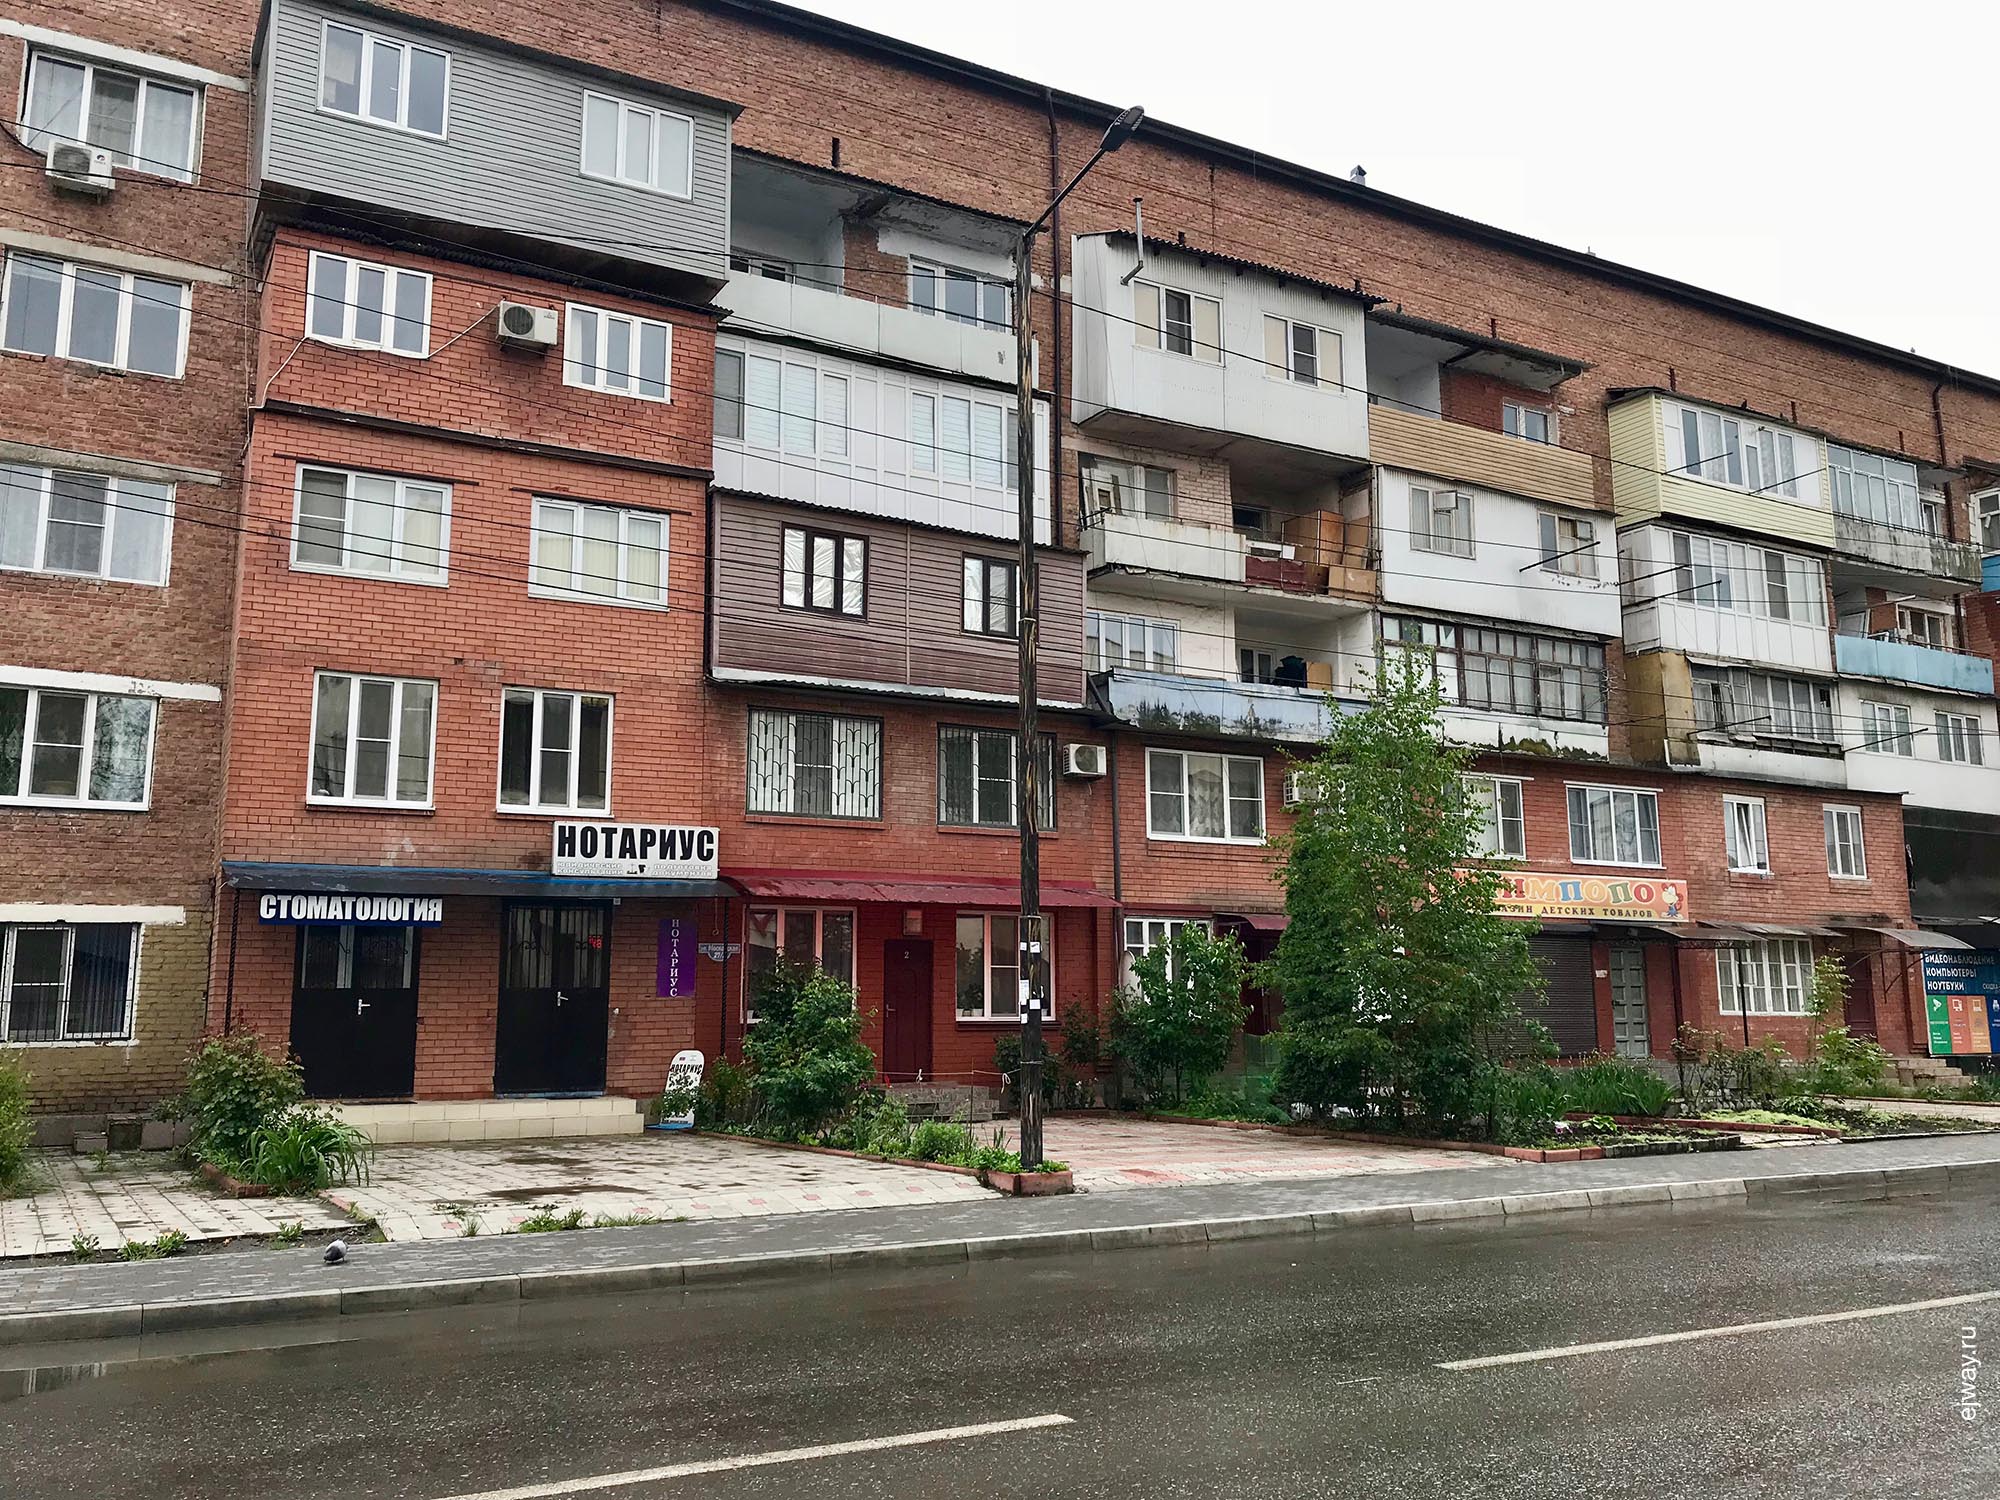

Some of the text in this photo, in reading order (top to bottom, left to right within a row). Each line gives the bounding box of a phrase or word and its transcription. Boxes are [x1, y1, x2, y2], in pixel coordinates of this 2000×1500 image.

[557, 825, 714, 862] НОТАРИУС
[1484, 877, 1655, 904] ИМПОПО
[259, 894, 443, 922] СТОМАТОЛОГИЯ
[1541, 905, 1595, 916] ДЕТСКИХ
[1602, 908, 1653, 918] ТОВАРОВ
[669, 919, 680, 997] НОТАРИУС
[1925, 953, 1995, 965] ВИДЕОНАБЛЮДЕНИЕ
[1926, 967, 1976, 977] КОМПЬЮТЕРЫ
[1927, 980, 1965, 991] НОУТБУКИ
